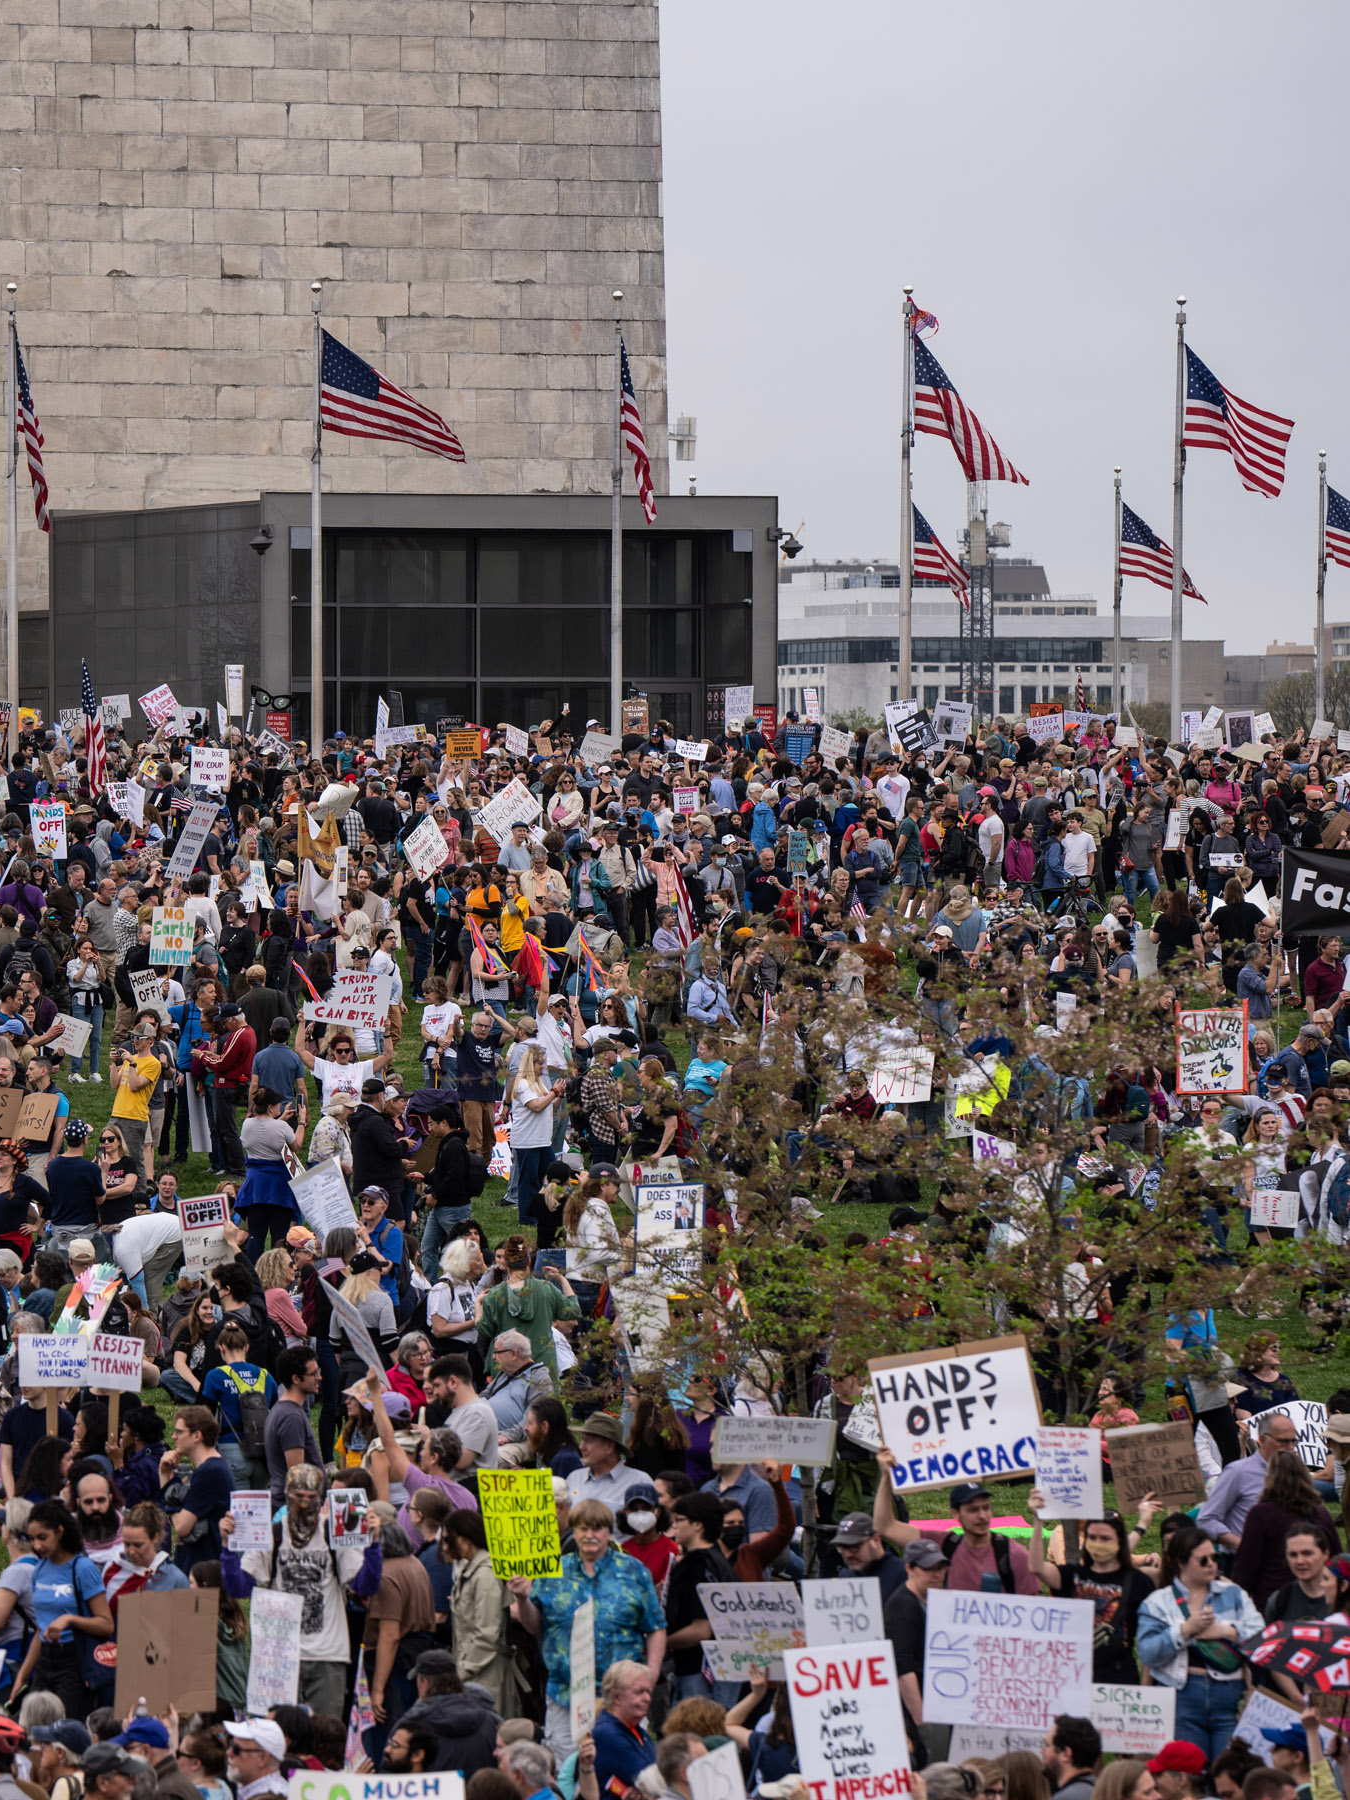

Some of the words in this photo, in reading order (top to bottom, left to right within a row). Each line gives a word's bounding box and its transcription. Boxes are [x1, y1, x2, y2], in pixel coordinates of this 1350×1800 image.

[727, 695, 751, 705] PEOPLE
[61, 708, 81, 720] RULE
[102, 705, 119, 715] LAW
[729, 705, 749, 713] MEANS
[1032, 716, 1058, 726] RESIST
[1027, 725, 1060, 736] FASCISM
[487, 796, 523, 831] BROWN
[39, 819, 64, 834] OFF!
[406, 828, 422, 848] KEEP
[164, 908, 184, 920] NO
[153, 921, 194, 939] Earth
[165, 937, 183, 949] NO
[130, 971, 157, 988] Hands
[339, 975, 378, 985] TRUMP
[138, 986, 162, 1002] OFF!
[353, 986, 374, 994] AND
[340, 994, 378, 1005] MUSK
[314, 1006, 344, 1019] CAN
[346, 1010, 375, 1021] BITE
[647, 1191, 671, 1201] DOES
[677, 1189, 698, 1199] THIS
[185, 1200, 220, 1212] HANDS
[186, 1209, 223, 1227] OFF!
[654, 1210, 672, 1220] ASS
[186, 1255, 200, 1265] NOT
[32, 1337, 57, 1348] HANDS
[59, 1337, 78, 1348] OFF
[93, 1334, 141, 1357] RESIST
[51, 1350, 71, 1358] CDC
[54, 1359, 87, 1367] FUNDING
[91, 1357, 140, 1376] TYRANNY
[37, 1368, 81, 1379] VACCINES
[876, 1357, 998, 1403] HANDS
[905, 1393, 998, 1437] OFF!
[523, 1474, 551, 1492] THE
[482, 1495, 532, 1514] KISSING
[535, 1494, 554, 1511] UP
[484, 1515, 504, 1537] TO
[490, 1537, 523, 1556] FIGHT
[529, 1535, 554, 1554] FOR
[492, 1554, 561, 1578] DEMOCRACY
[710, 1590, 747, 1613] God
[951, 1597, 1026, 1628] HANDS
[1030, 1606, 1073, 1635] OFF
[975, 1635, 1078, 1662] HEALTHCARE
[928, 1631, 972, 1699] OUR
[978, 1656, 1087, 1684] DEMOCRACY
[793, 1656, 889, 1698] SAVE
[978, 1677, 1070, 1699] DIVERSITY
[1093, 1686, 1135, 1703] SICK
[820, 1697, 859, 1720] Jobs
[974, 1696, 1052, 1713] ECONOMY
[1121, 1703, 1162, 1715] TIRED
[822, 1738, 875, 1760] Schools
[830, 1761, 870, 1778] Lives
[364, 1778, 439, 1799] MUCH
